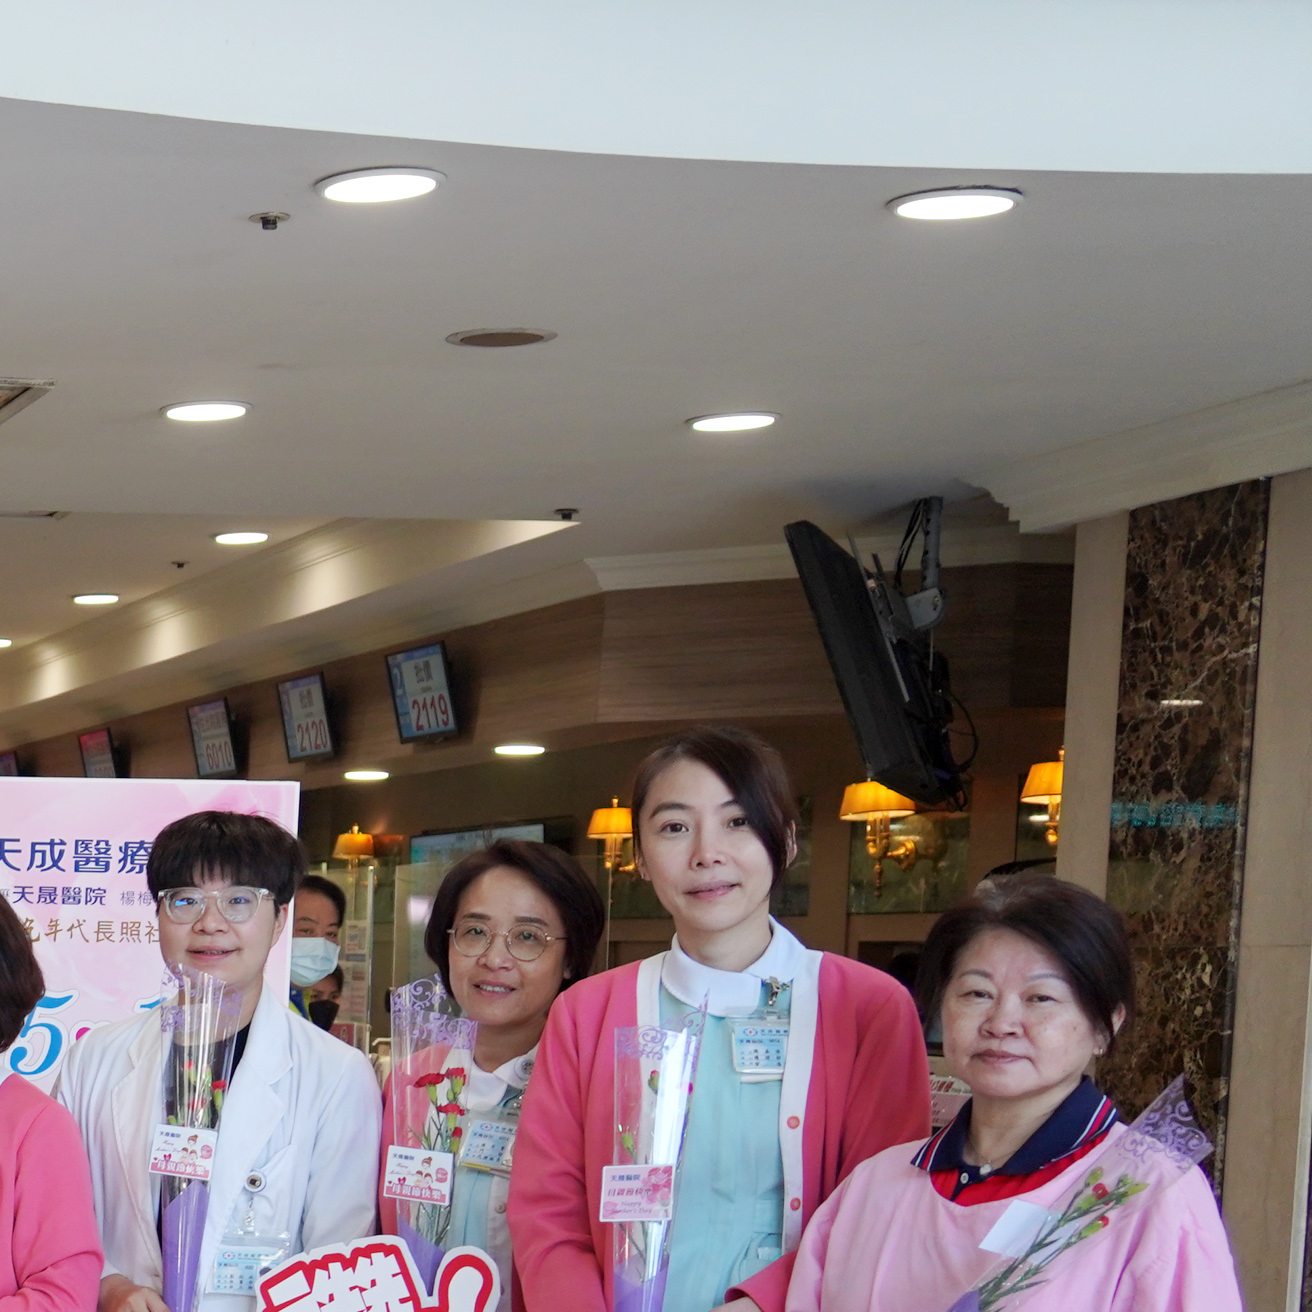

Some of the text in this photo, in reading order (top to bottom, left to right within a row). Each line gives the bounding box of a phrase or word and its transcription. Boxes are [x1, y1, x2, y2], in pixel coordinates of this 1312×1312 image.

[411, 693, 450, 732] 2119
[296, 718, 328, 753] 2120
[12, 885, 107, 906] 天晟醫院
